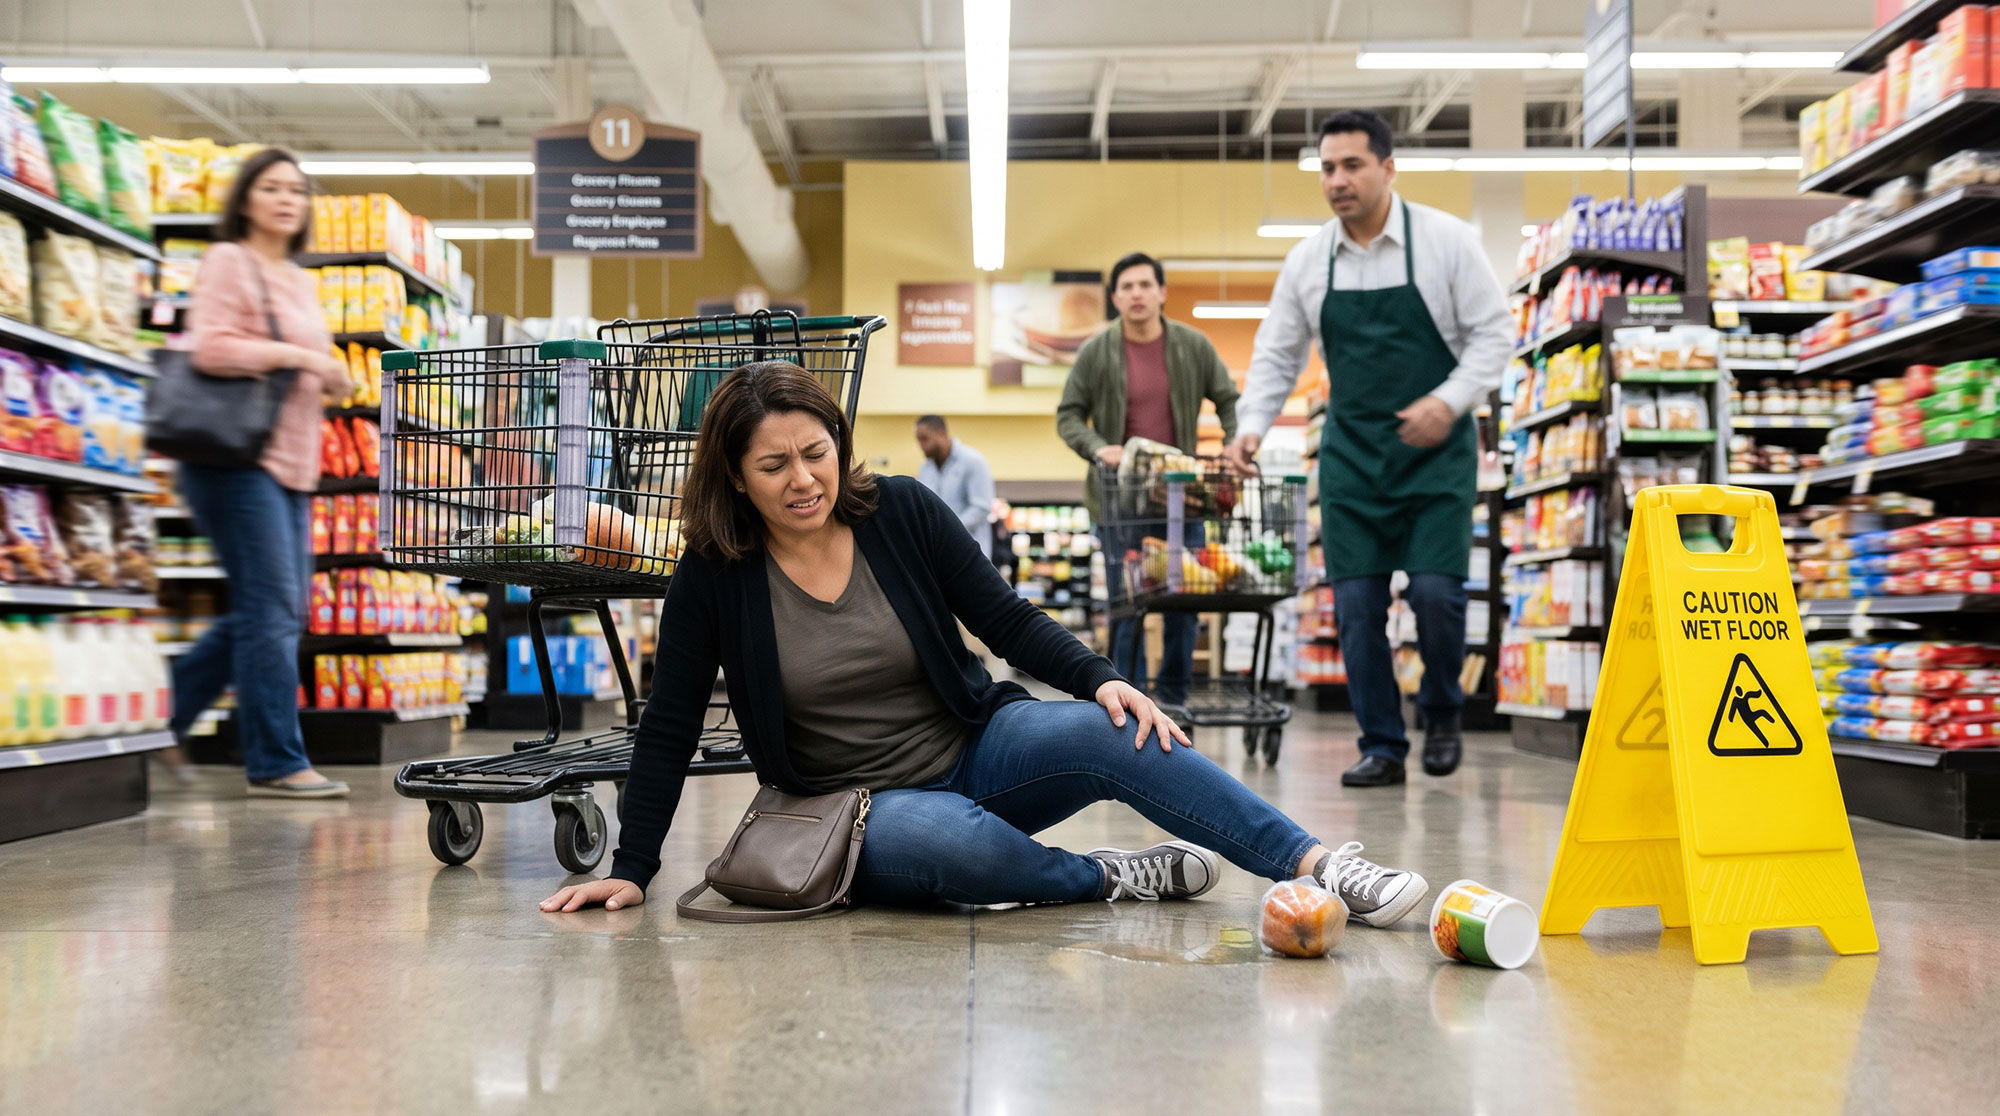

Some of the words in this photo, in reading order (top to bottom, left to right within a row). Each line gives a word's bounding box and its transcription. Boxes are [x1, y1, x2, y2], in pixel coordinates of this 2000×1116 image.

[600, 118, 631, 148] 11
[1683, 591, 1779, 614] CAUTION
[1681, 620, 1722, 640] WET
[1727, 620, 1790, 640] FLOOR
